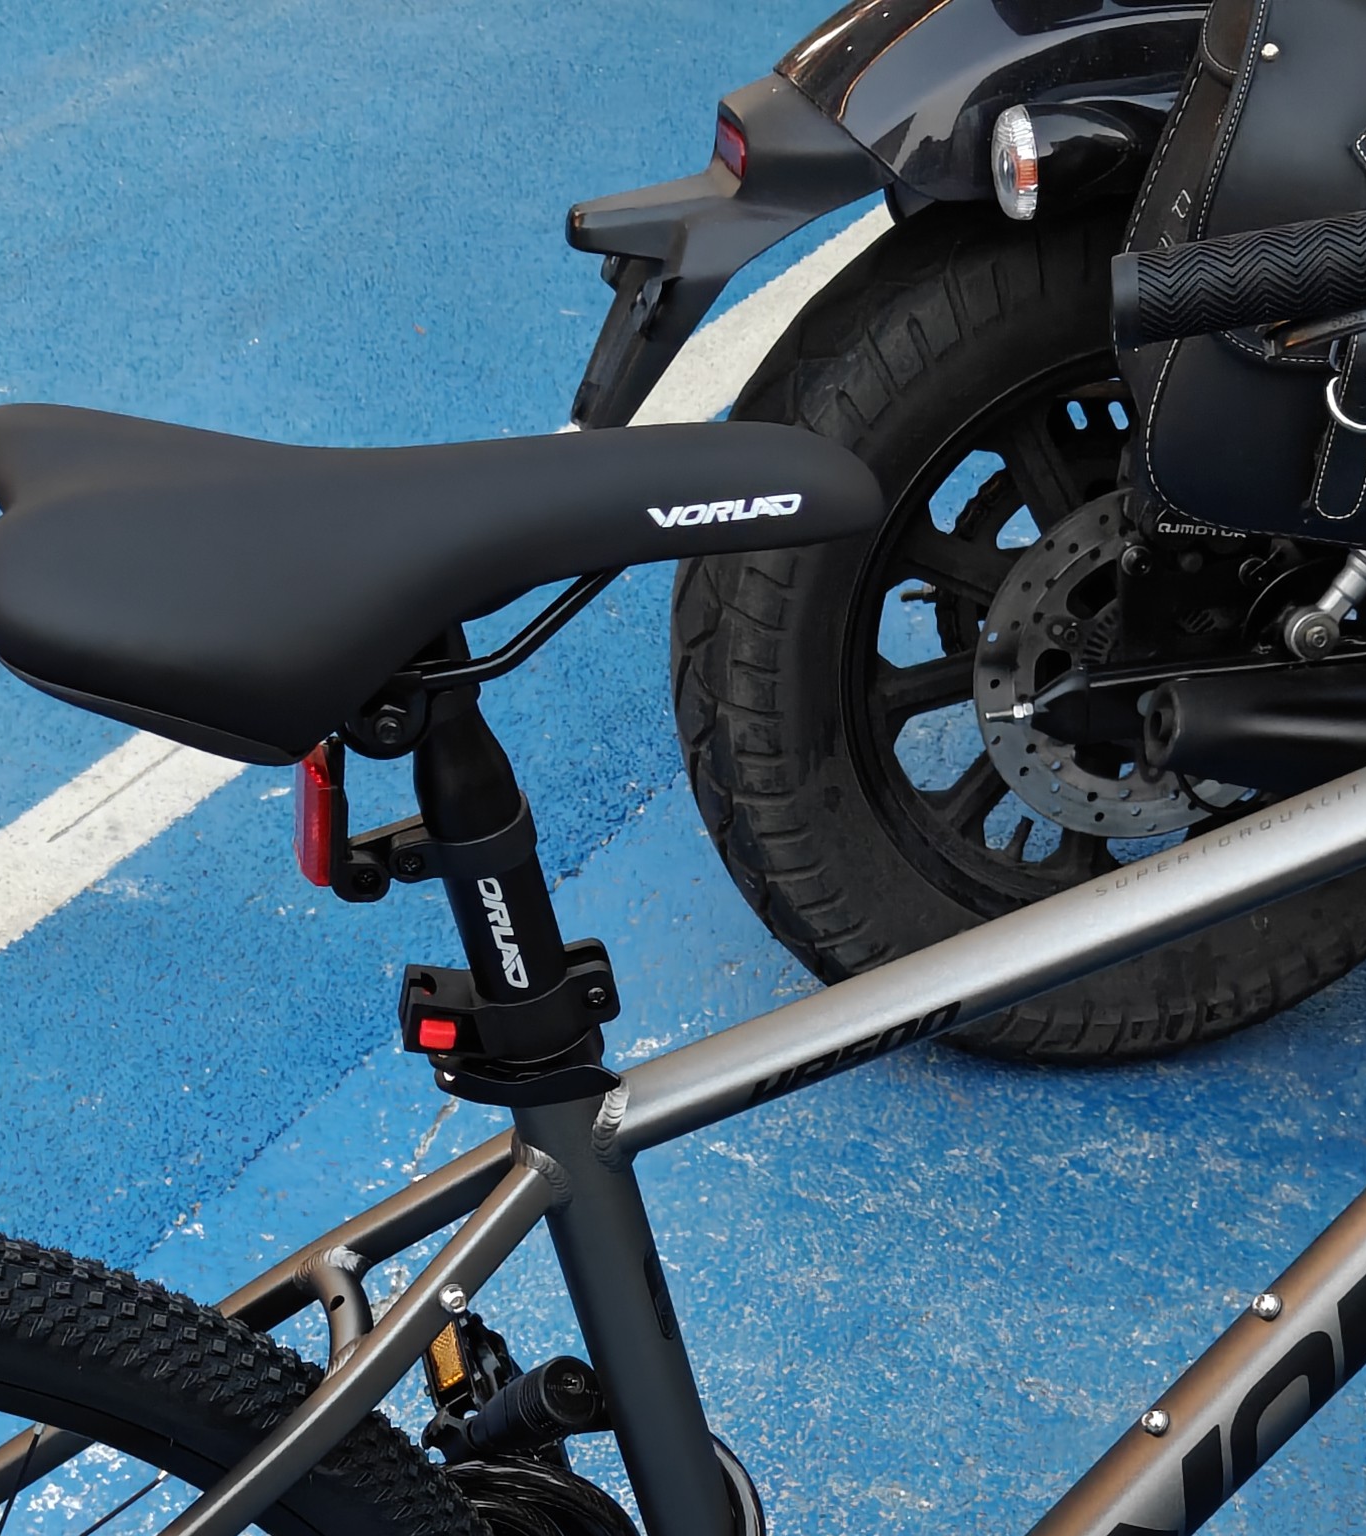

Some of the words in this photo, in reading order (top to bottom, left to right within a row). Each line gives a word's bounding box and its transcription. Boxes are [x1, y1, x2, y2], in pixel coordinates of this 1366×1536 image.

[646, 493, 802, 528] VORLAD
[1095, 826, 1253, 897] SUPERIOR
[477, 877, 529, 989] ORLAD
